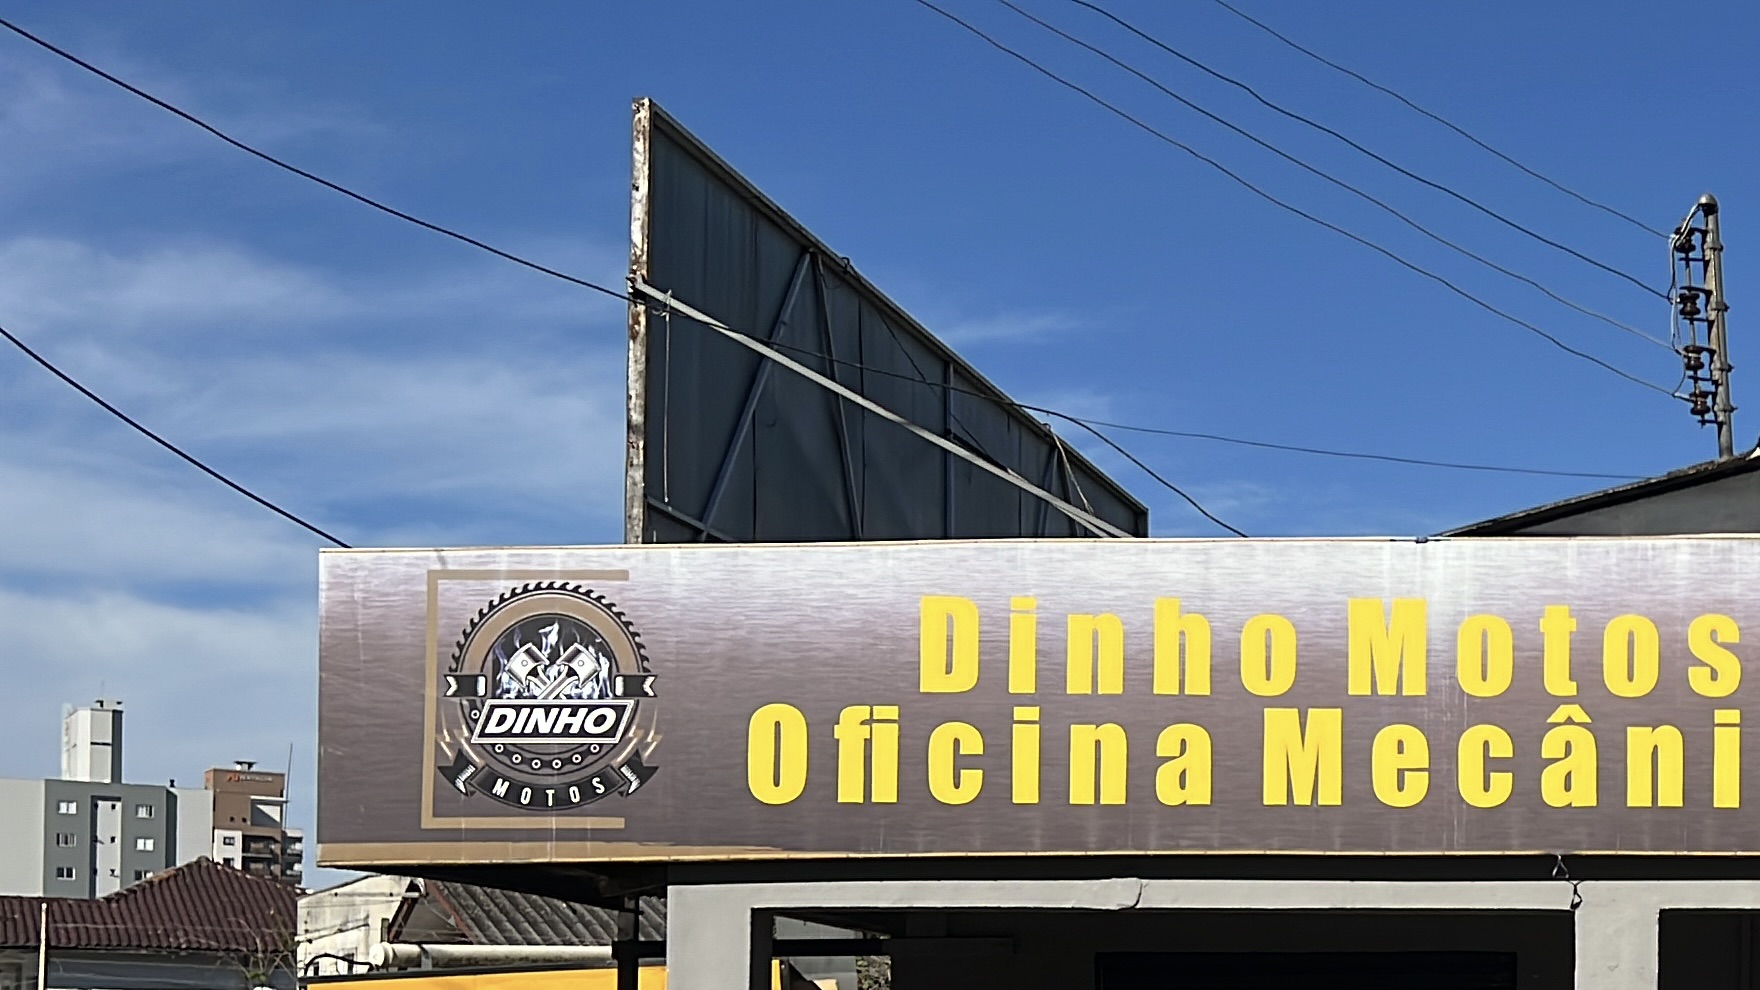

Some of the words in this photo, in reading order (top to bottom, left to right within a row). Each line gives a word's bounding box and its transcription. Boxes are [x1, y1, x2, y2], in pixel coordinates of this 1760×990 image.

[919, 594, 1298, 697] Dinho
[1347, 597, 1742, 698] Motos
[484, 706, 618, 735] DINHO
[747, 702, 1213, 805] Oficina
[492, 777, 606, 807] MOTOS
